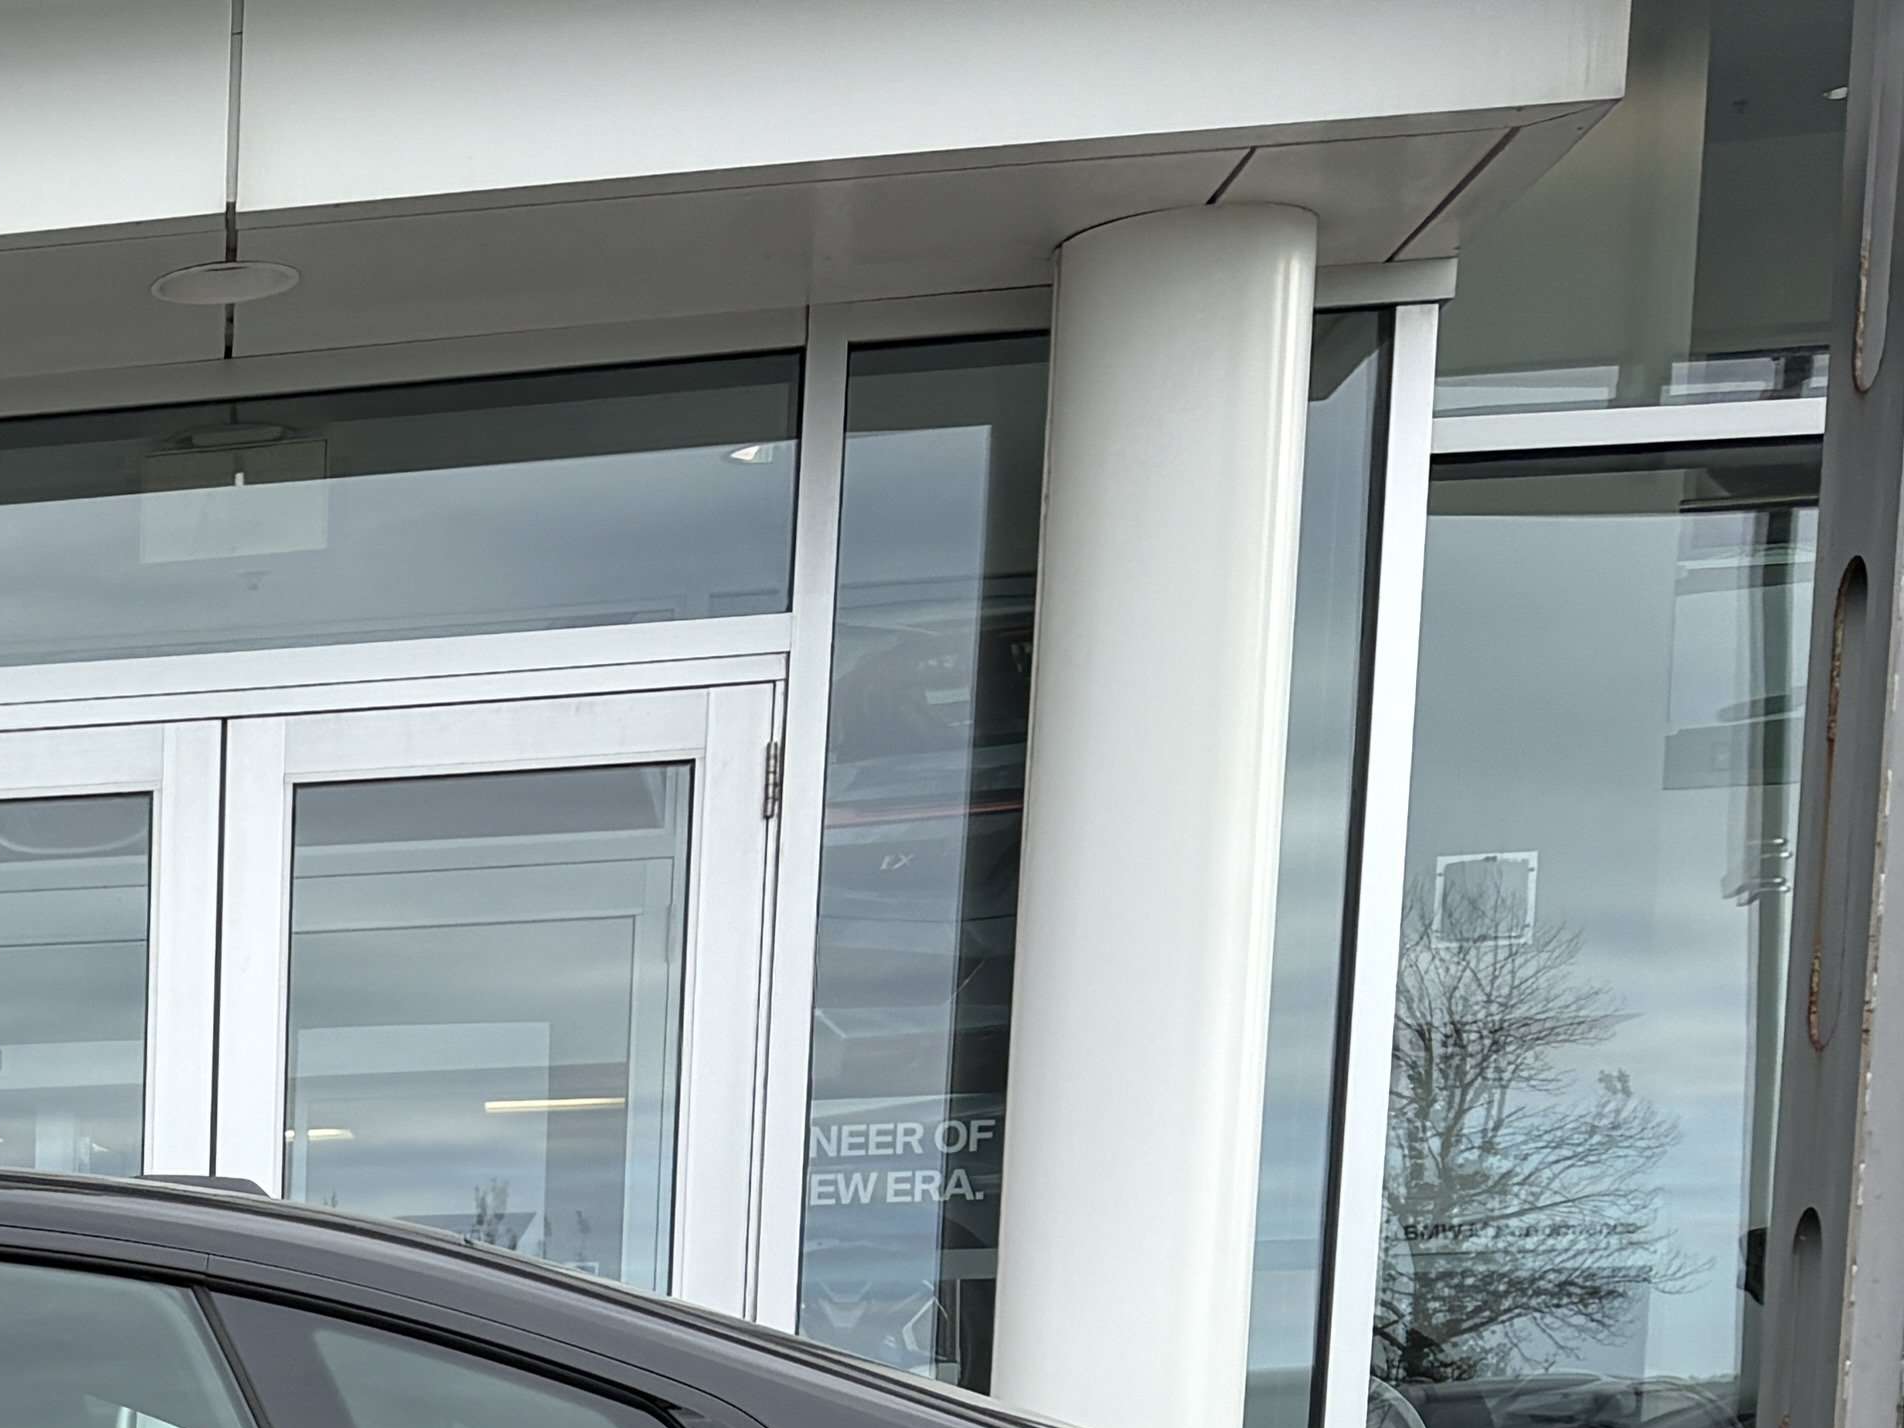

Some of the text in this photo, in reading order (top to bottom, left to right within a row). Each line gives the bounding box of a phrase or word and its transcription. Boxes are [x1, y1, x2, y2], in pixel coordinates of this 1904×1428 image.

[809, 1120, 996, 1158] NEER OF
[809, 1168, 985, 1206] EW ERA.
